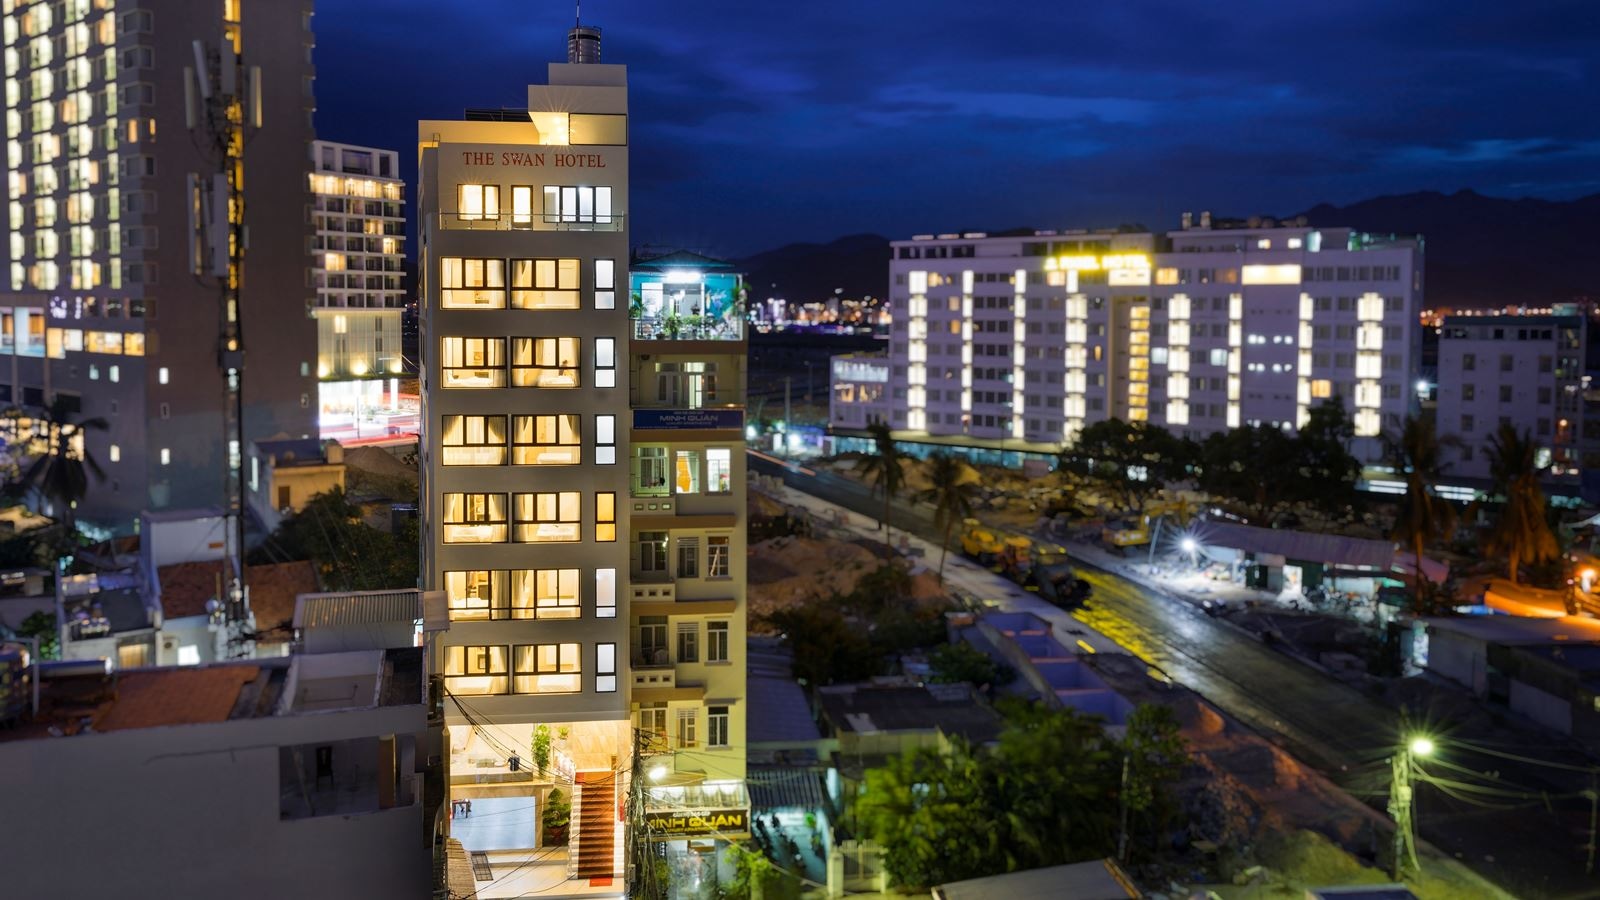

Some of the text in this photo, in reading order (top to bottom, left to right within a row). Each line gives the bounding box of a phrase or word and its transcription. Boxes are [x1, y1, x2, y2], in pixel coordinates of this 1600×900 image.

[462, 152, 606, 168] THE SWAN HOTEL
